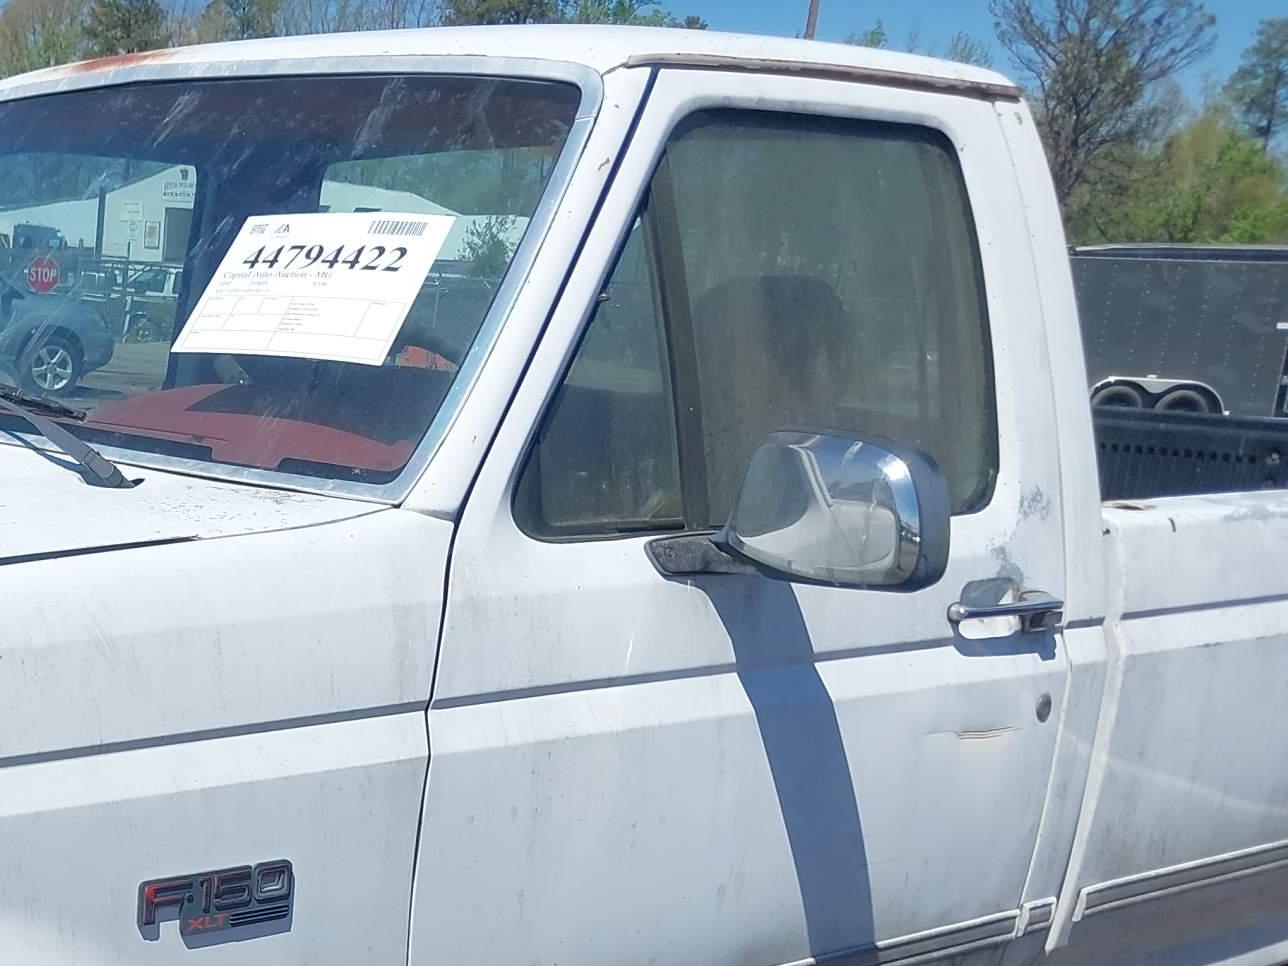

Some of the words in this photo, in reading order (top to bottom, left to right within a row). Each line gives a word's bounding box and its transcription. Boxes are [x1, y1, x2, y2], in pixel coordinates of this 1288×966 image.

[242, 245, 408, 273] 44794422
[29, 268, 58, 282] STOP
[274, 271, 307, 279] Auction
[187, 912, 229, 932] XLT
